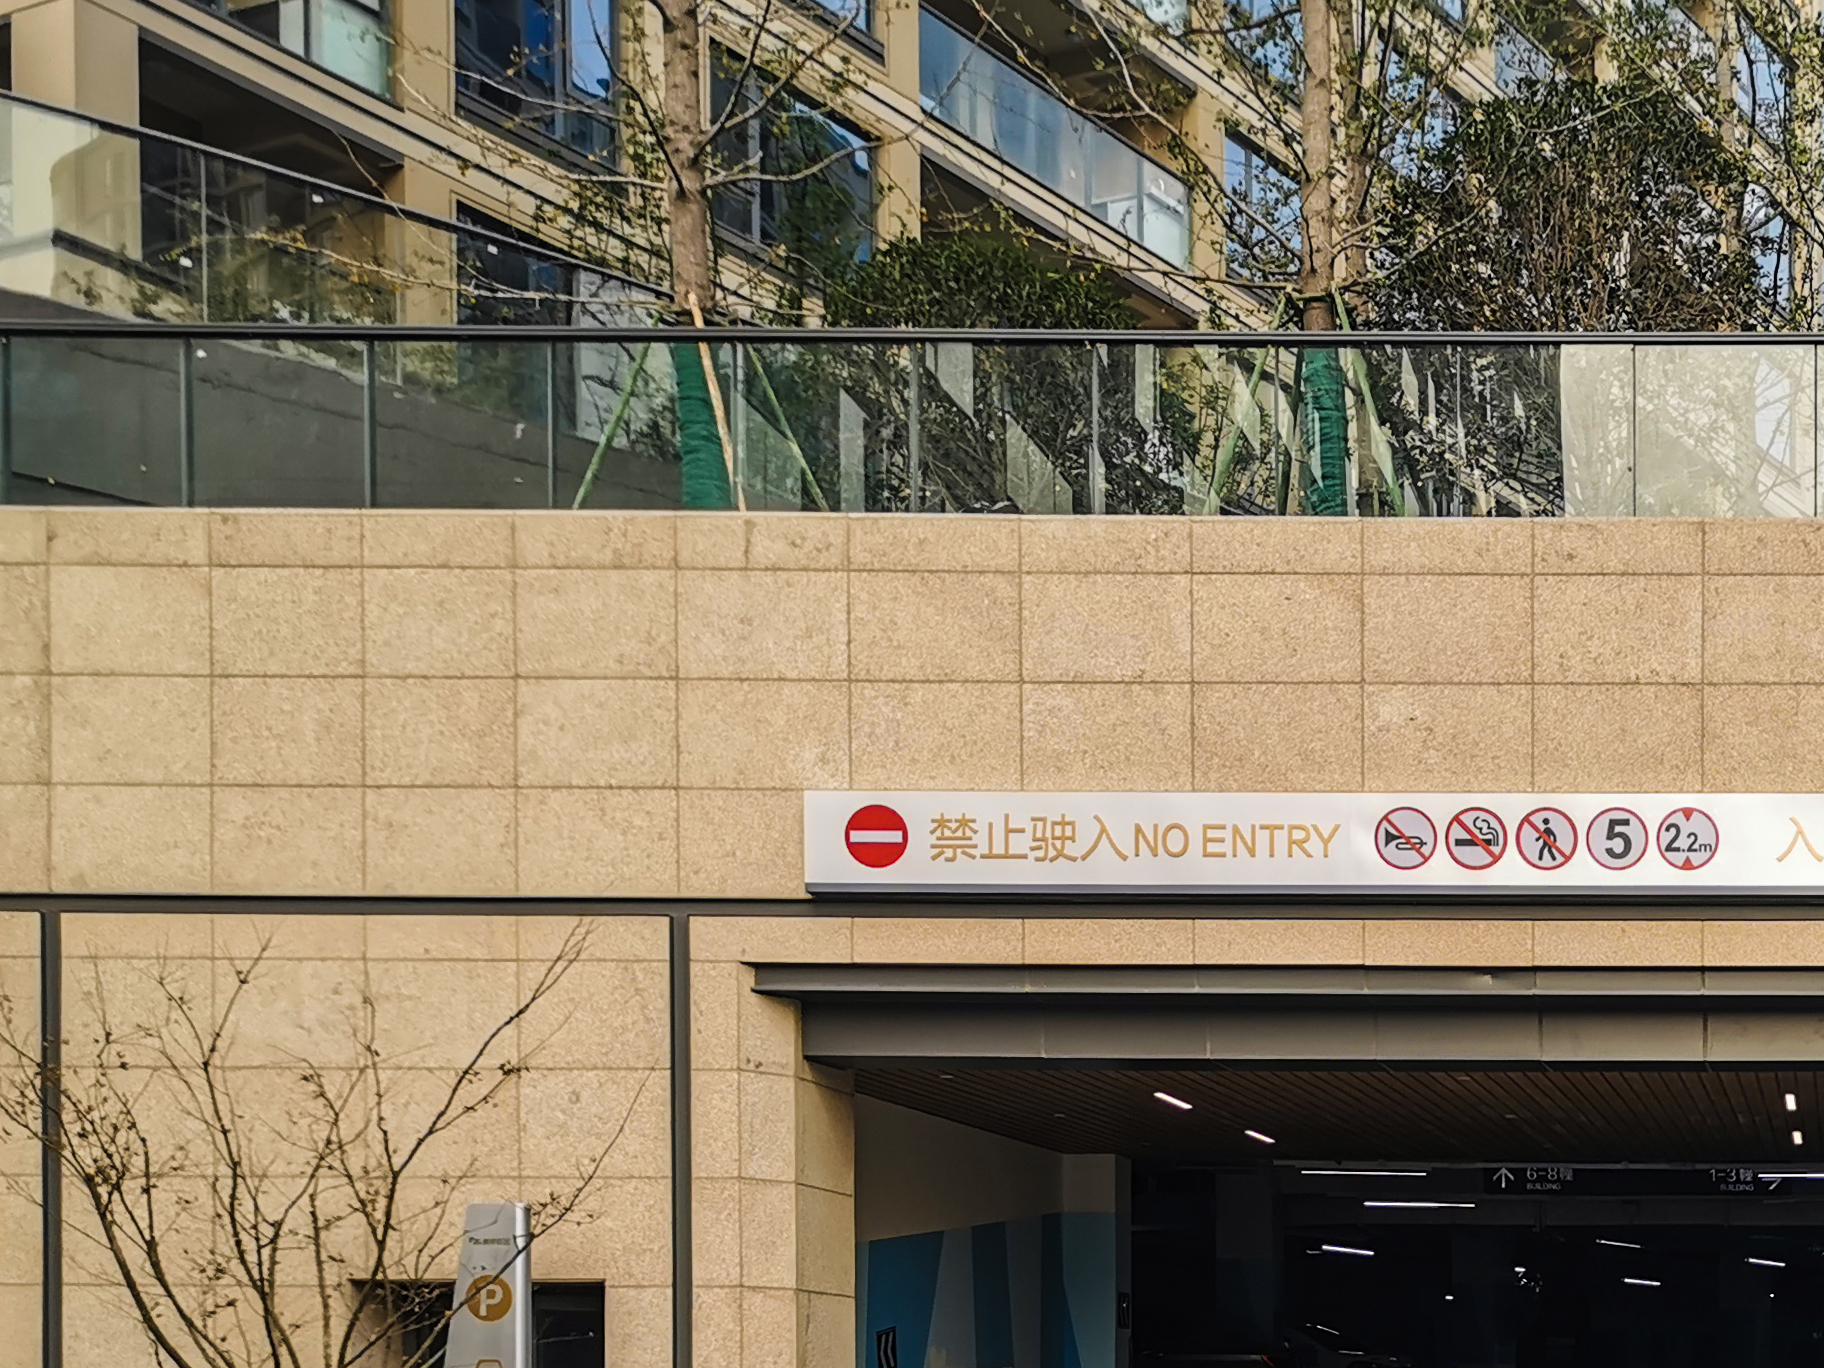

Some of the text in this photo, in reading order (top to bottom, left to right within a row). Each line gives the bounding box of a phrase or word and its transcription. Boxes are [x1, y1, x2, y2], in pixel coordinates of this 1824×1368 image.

[929, 812, 1341, 862] 禁止驶入 NO ENTRY
[1605, 818, 1632, 860] 5
[1664, 822, 1713, 853] 2.2m
